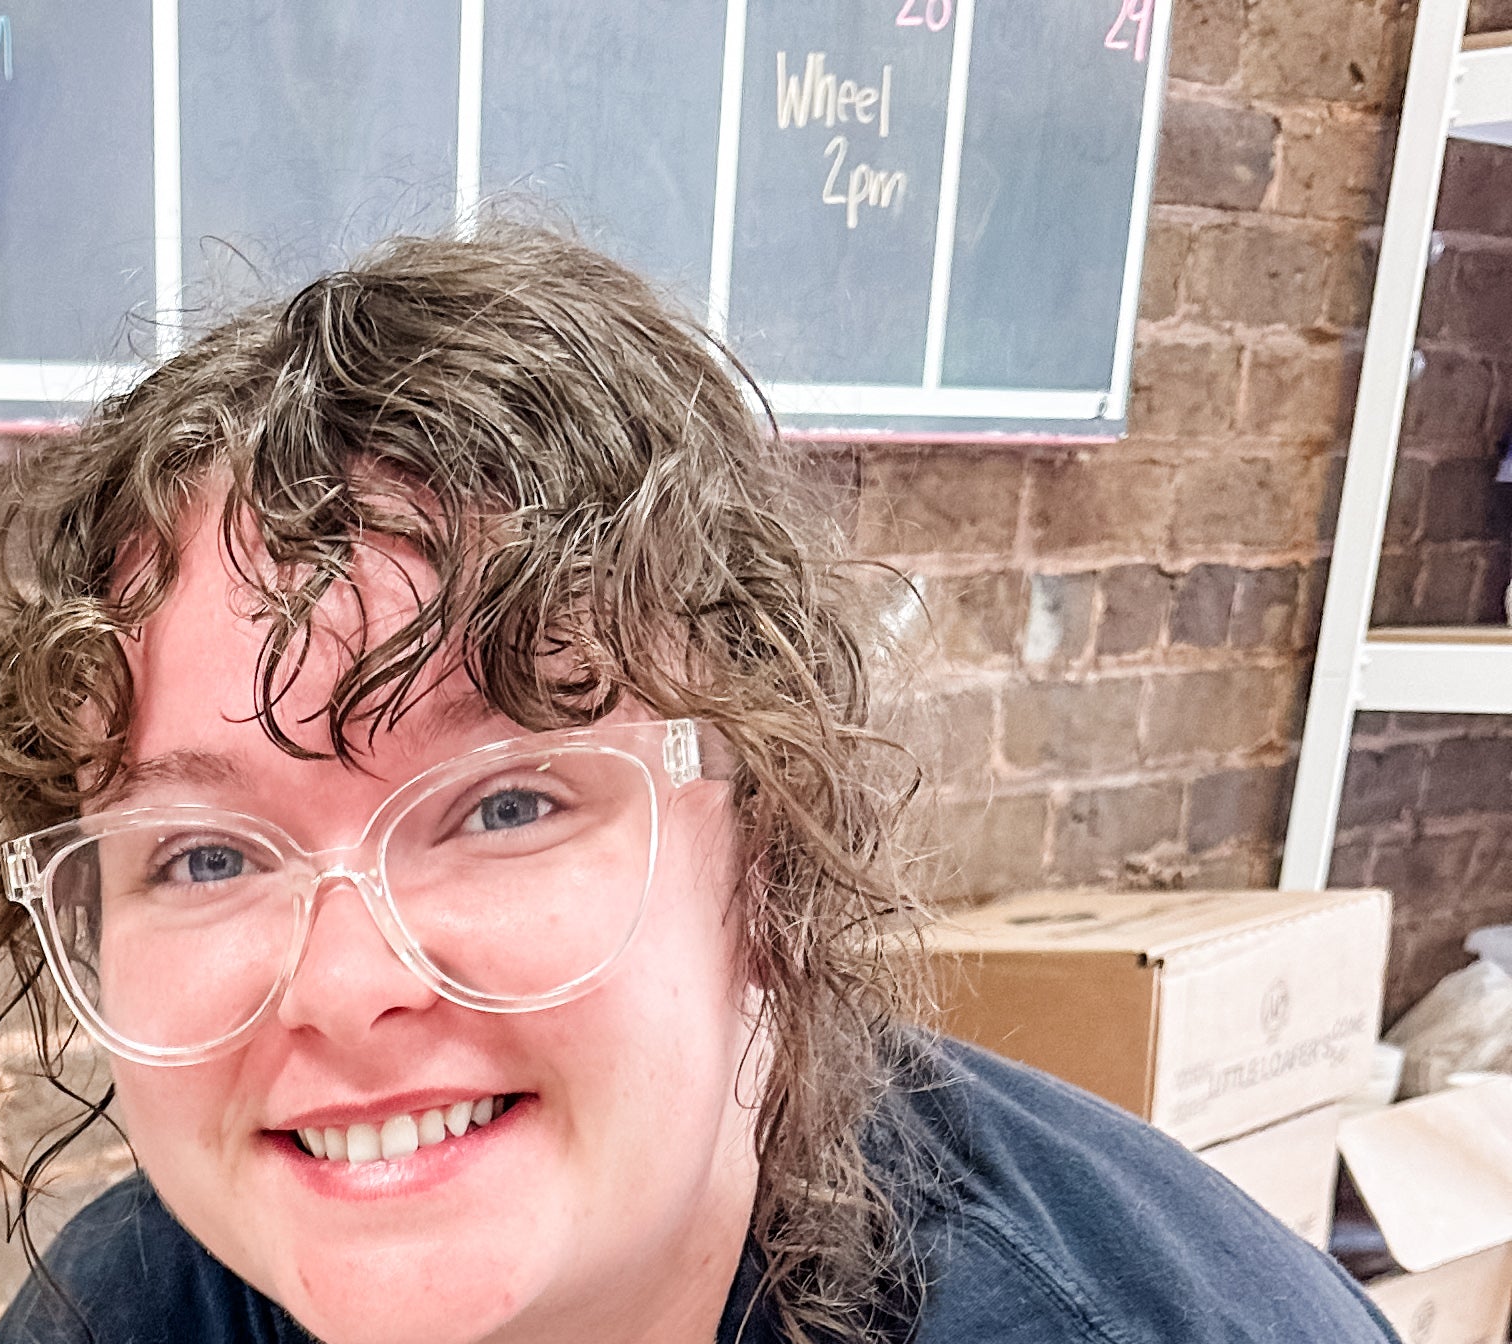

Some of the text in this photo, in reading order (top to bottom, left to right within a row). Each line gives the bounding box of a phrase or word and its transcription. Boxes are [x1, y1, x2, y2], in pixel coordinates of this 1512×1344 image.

[1104, 0, 1154, 62] 29
[777, 51, 892, 137] Wheel
[822, 135, 908, 229] 2pm
